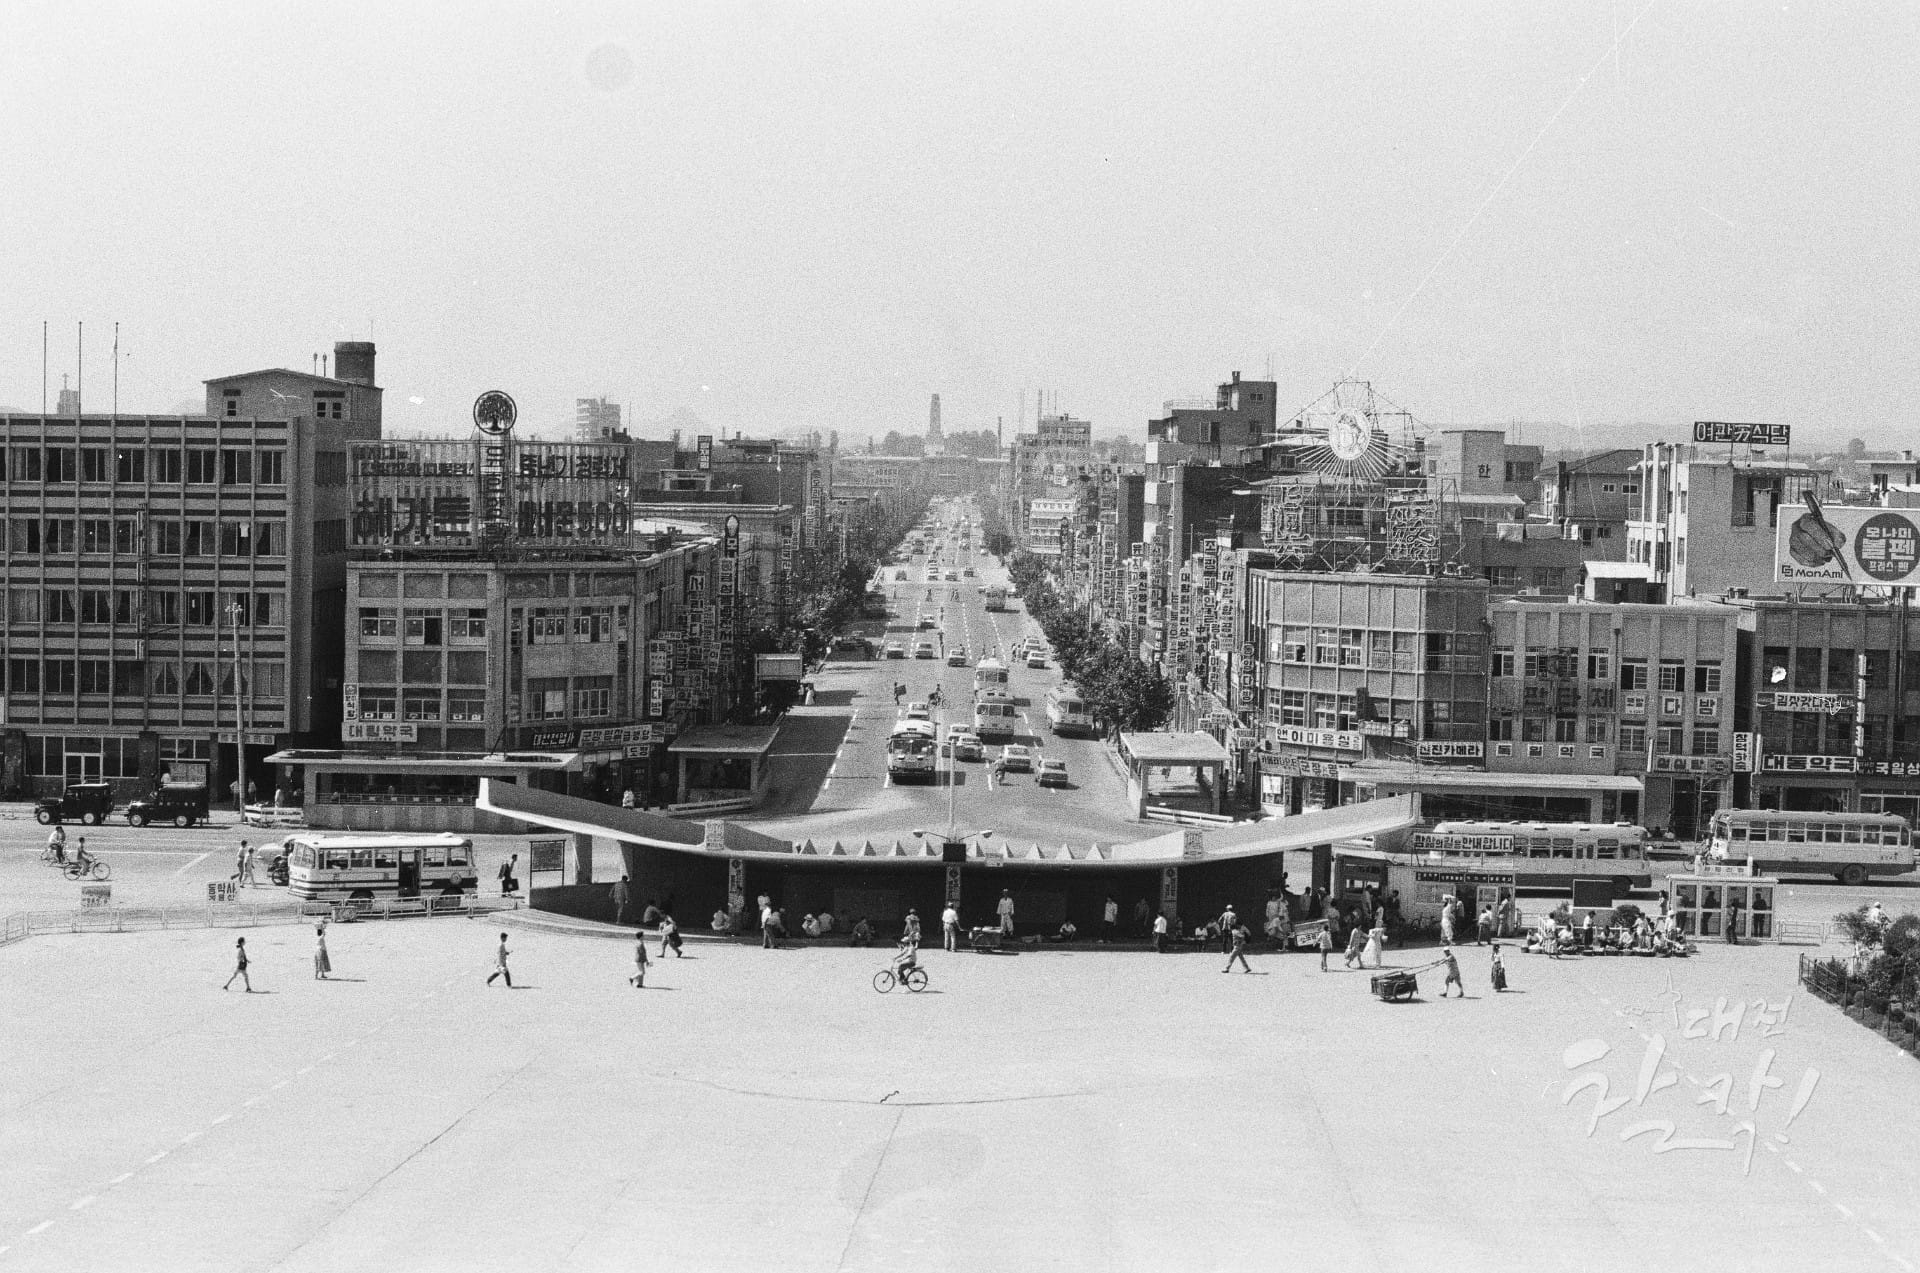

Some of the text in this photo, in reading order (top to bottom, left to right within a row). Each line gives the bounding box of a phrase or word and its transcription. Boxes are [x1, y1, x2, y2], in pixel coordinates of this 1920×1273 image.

[1866, 527, 1912, 539] 모나미
[1861, 538, 1916, 560] 볼펜
[1795, 568, 1844, 579] MonAmi
[1664, 698, 1716, 715] 다방
[348, 725, 413, 738] 대림약국
[1419, 744, 1480, 756] 신진카메라
[1764, 755, 1856, 772] 대동약국
[1462, 837, 1513, 851] 안내합니다
